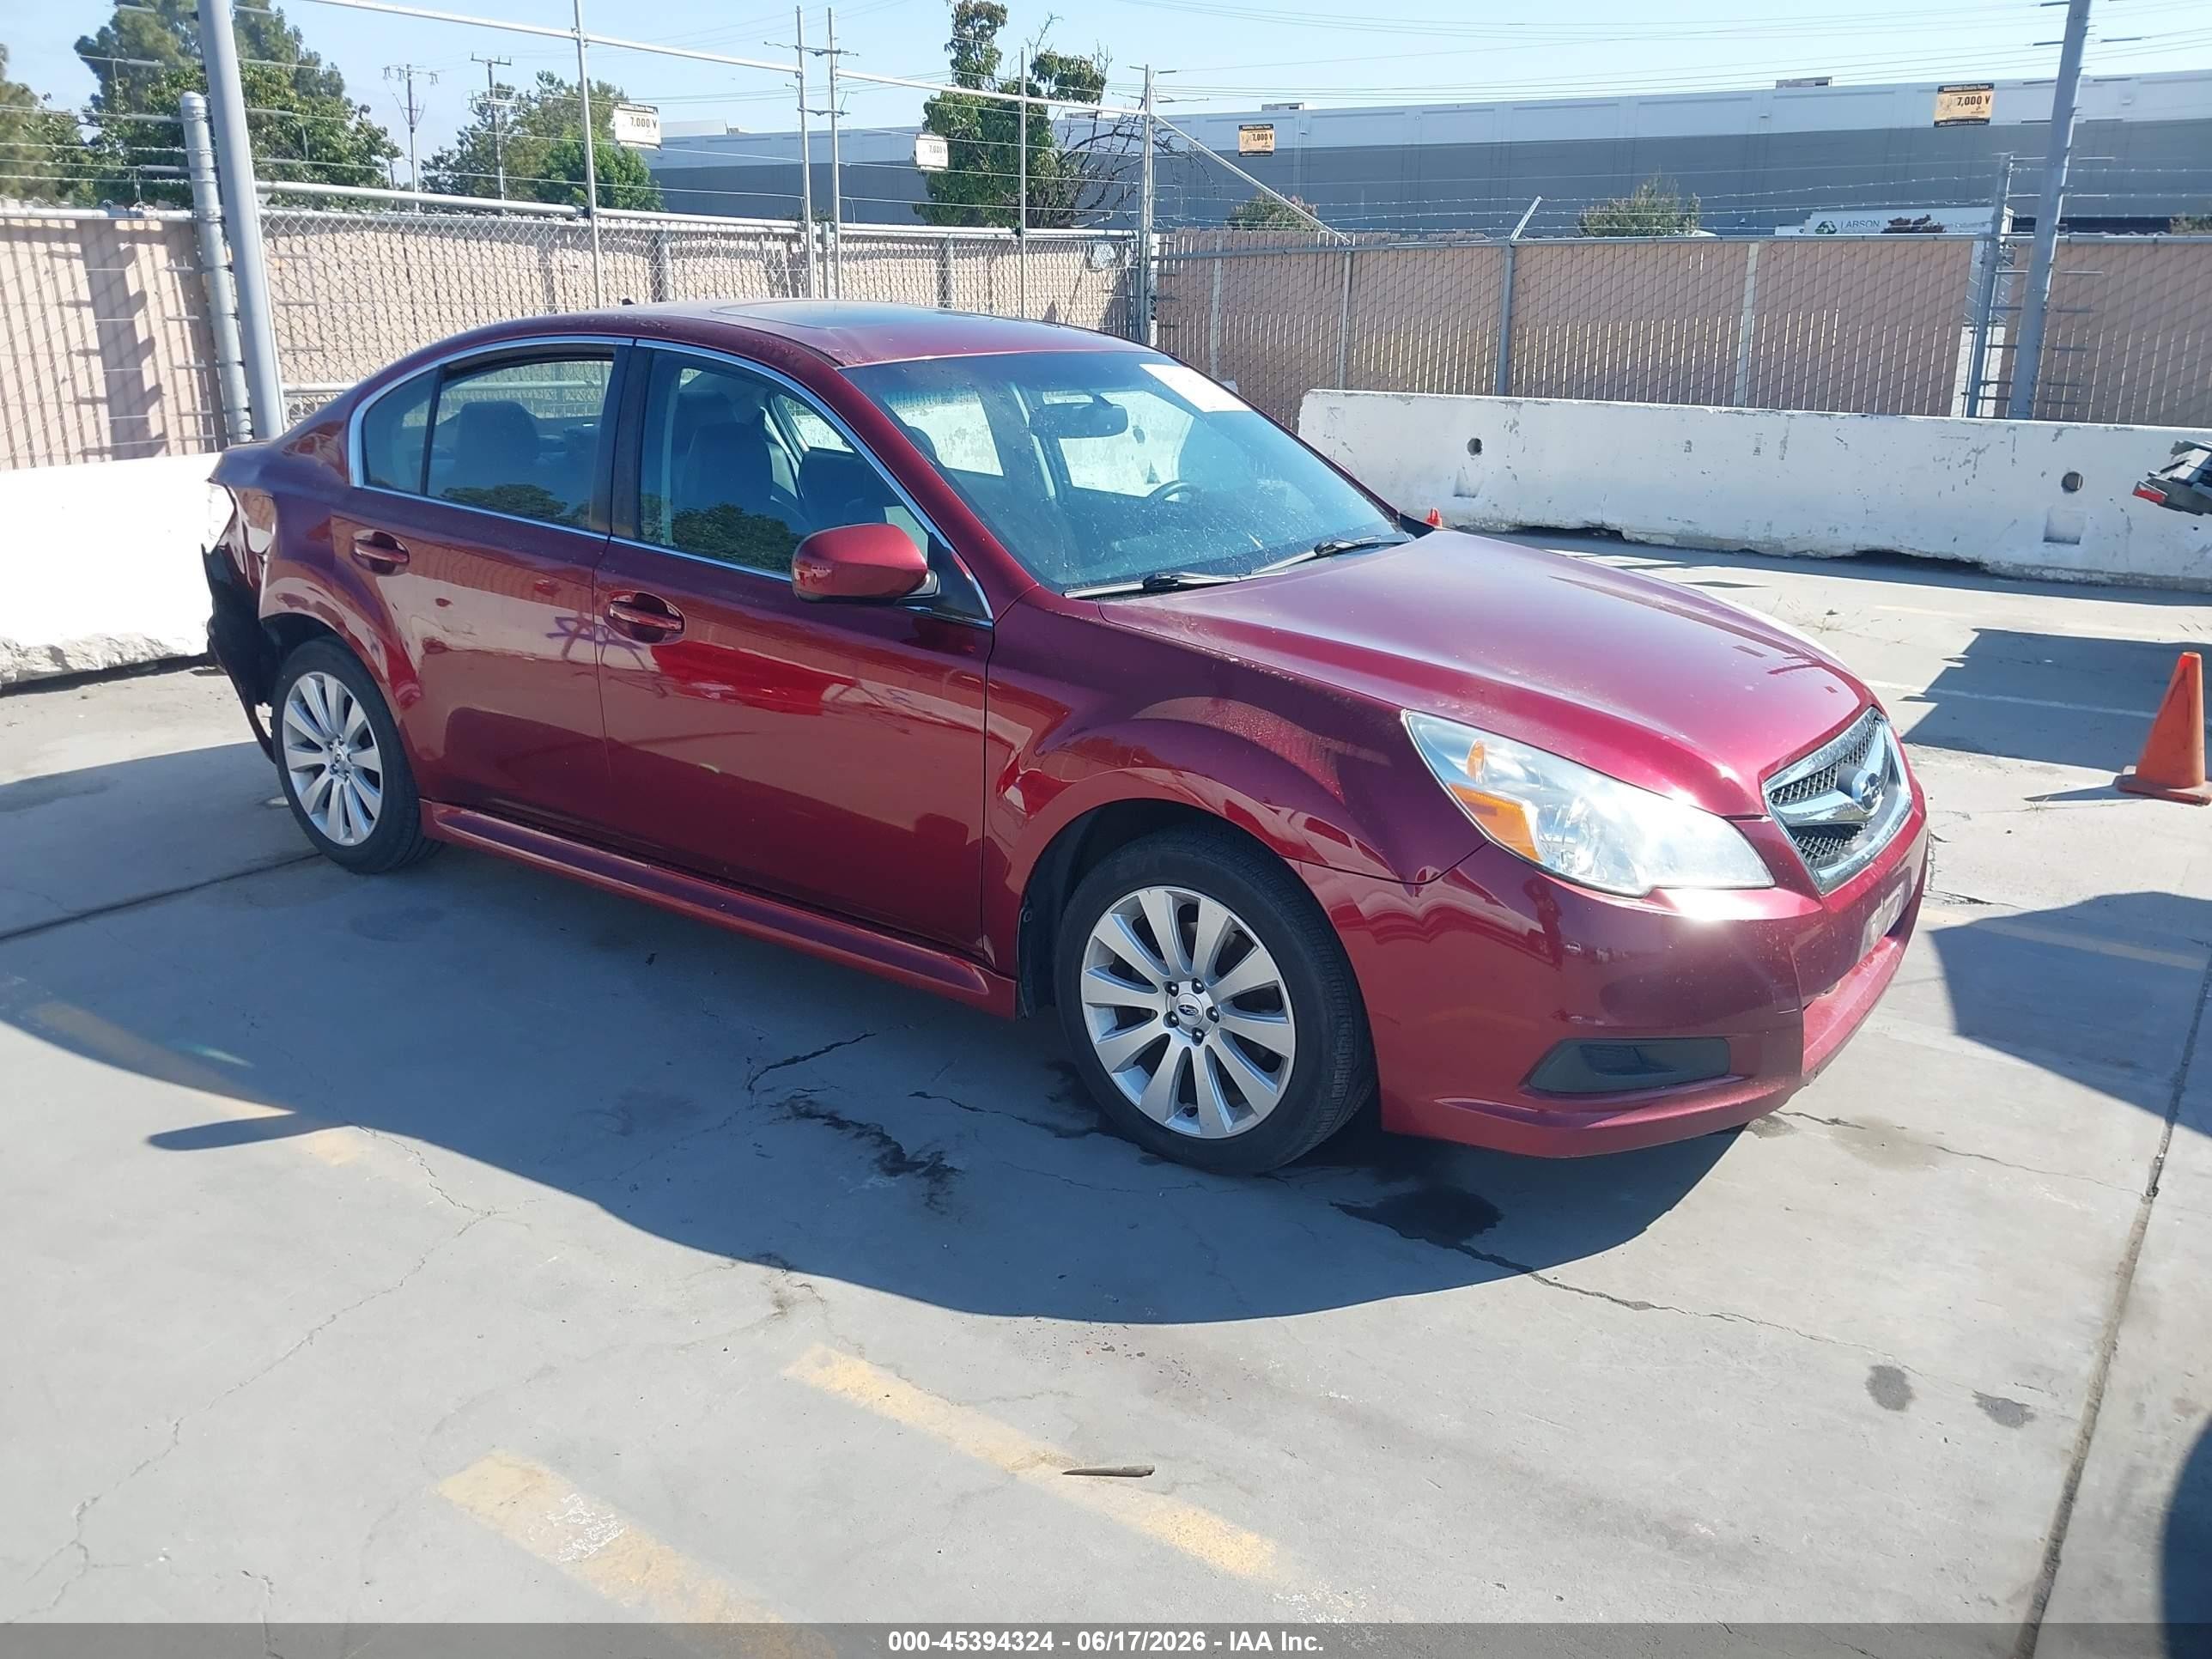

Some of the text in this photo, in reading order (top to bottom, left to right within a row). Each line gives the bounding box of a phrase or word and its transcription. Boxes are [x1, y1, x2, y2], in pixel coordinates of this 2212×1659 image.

[1957, 94, 1991, 106] 7,000 V
[652, 119, 658, 130] V
